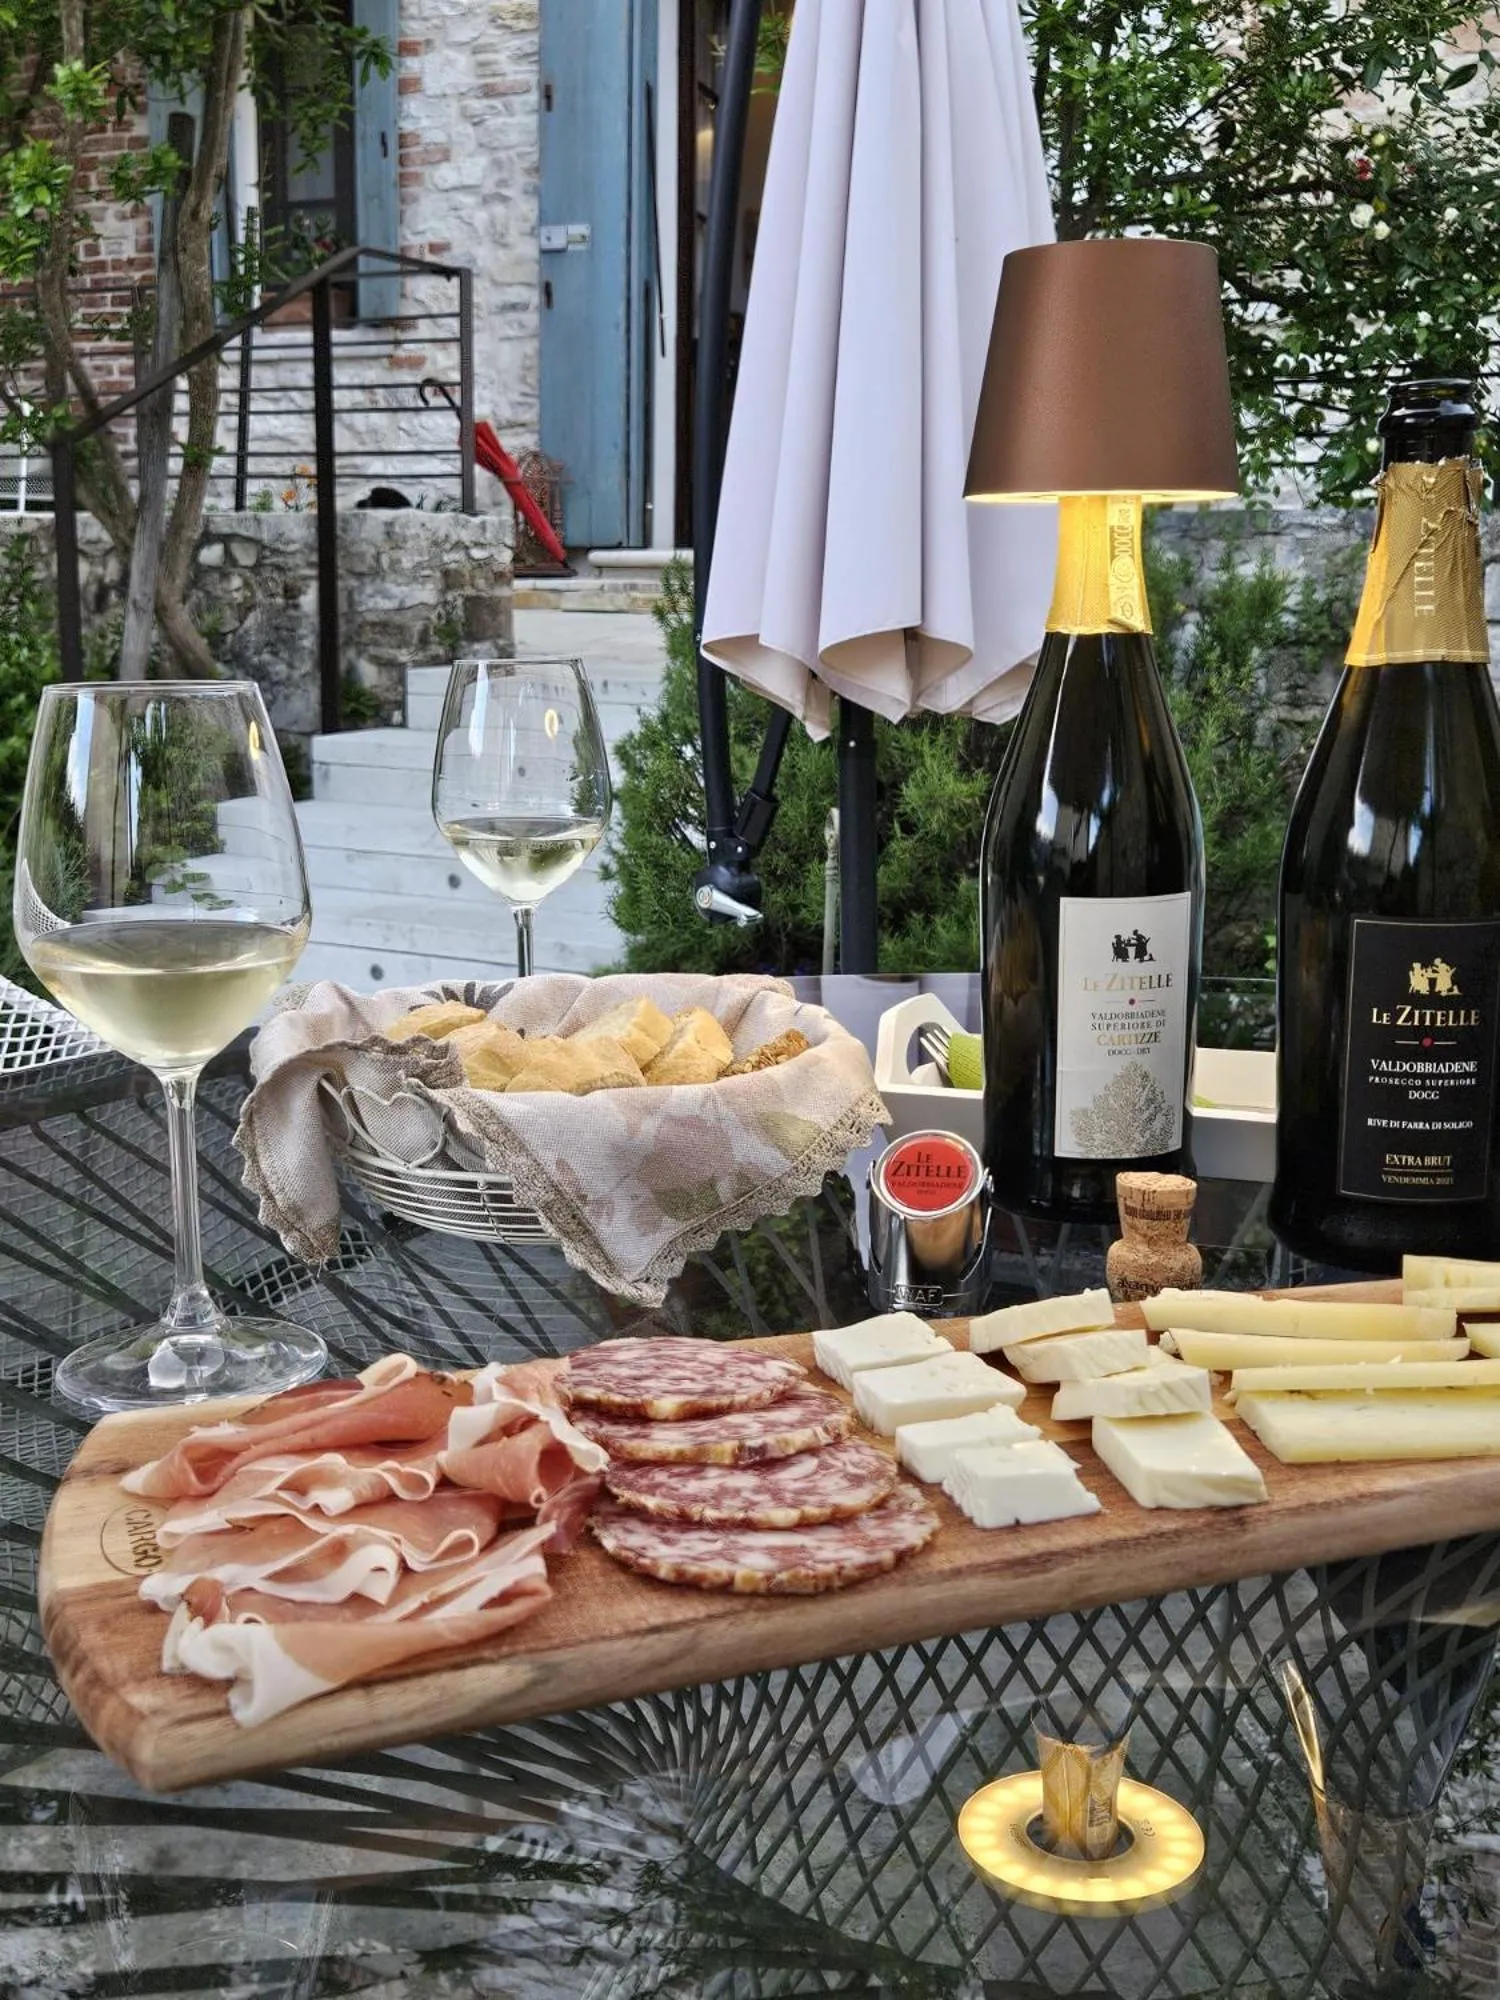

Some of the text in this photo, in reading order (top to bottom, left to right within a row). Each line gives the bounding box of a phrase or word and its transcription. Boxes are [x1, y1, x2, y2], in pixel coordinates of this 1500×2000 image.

[1104, 972, 1173, 991] ZITELLE
[1090, 1009, 1167, 1021] VALDOBBIADENE
[1371, 1004, 1481, 1027] LE ZITELLE
[1090, 1019, 1166, 1032] SUPERIORE DI
[1097, 1031, 1162, 1046] CARTIZZE
[1370, 1058, 1478, 1073] VALDOBBIADENE
[1368, 1075, 1477, 1087] PROSECCO SUPERIORE
[1367, 1117, 1474, 1130] RIVE DI FARRA DI SOLIGO
[917, 1151, 931, 1163] LE
[1385, 1153, 1453, 1167] EXTRA BRUT
[891, 1160, 968, 1178] ZITELLE
[124, 1508, 164, 1568] CARGO
